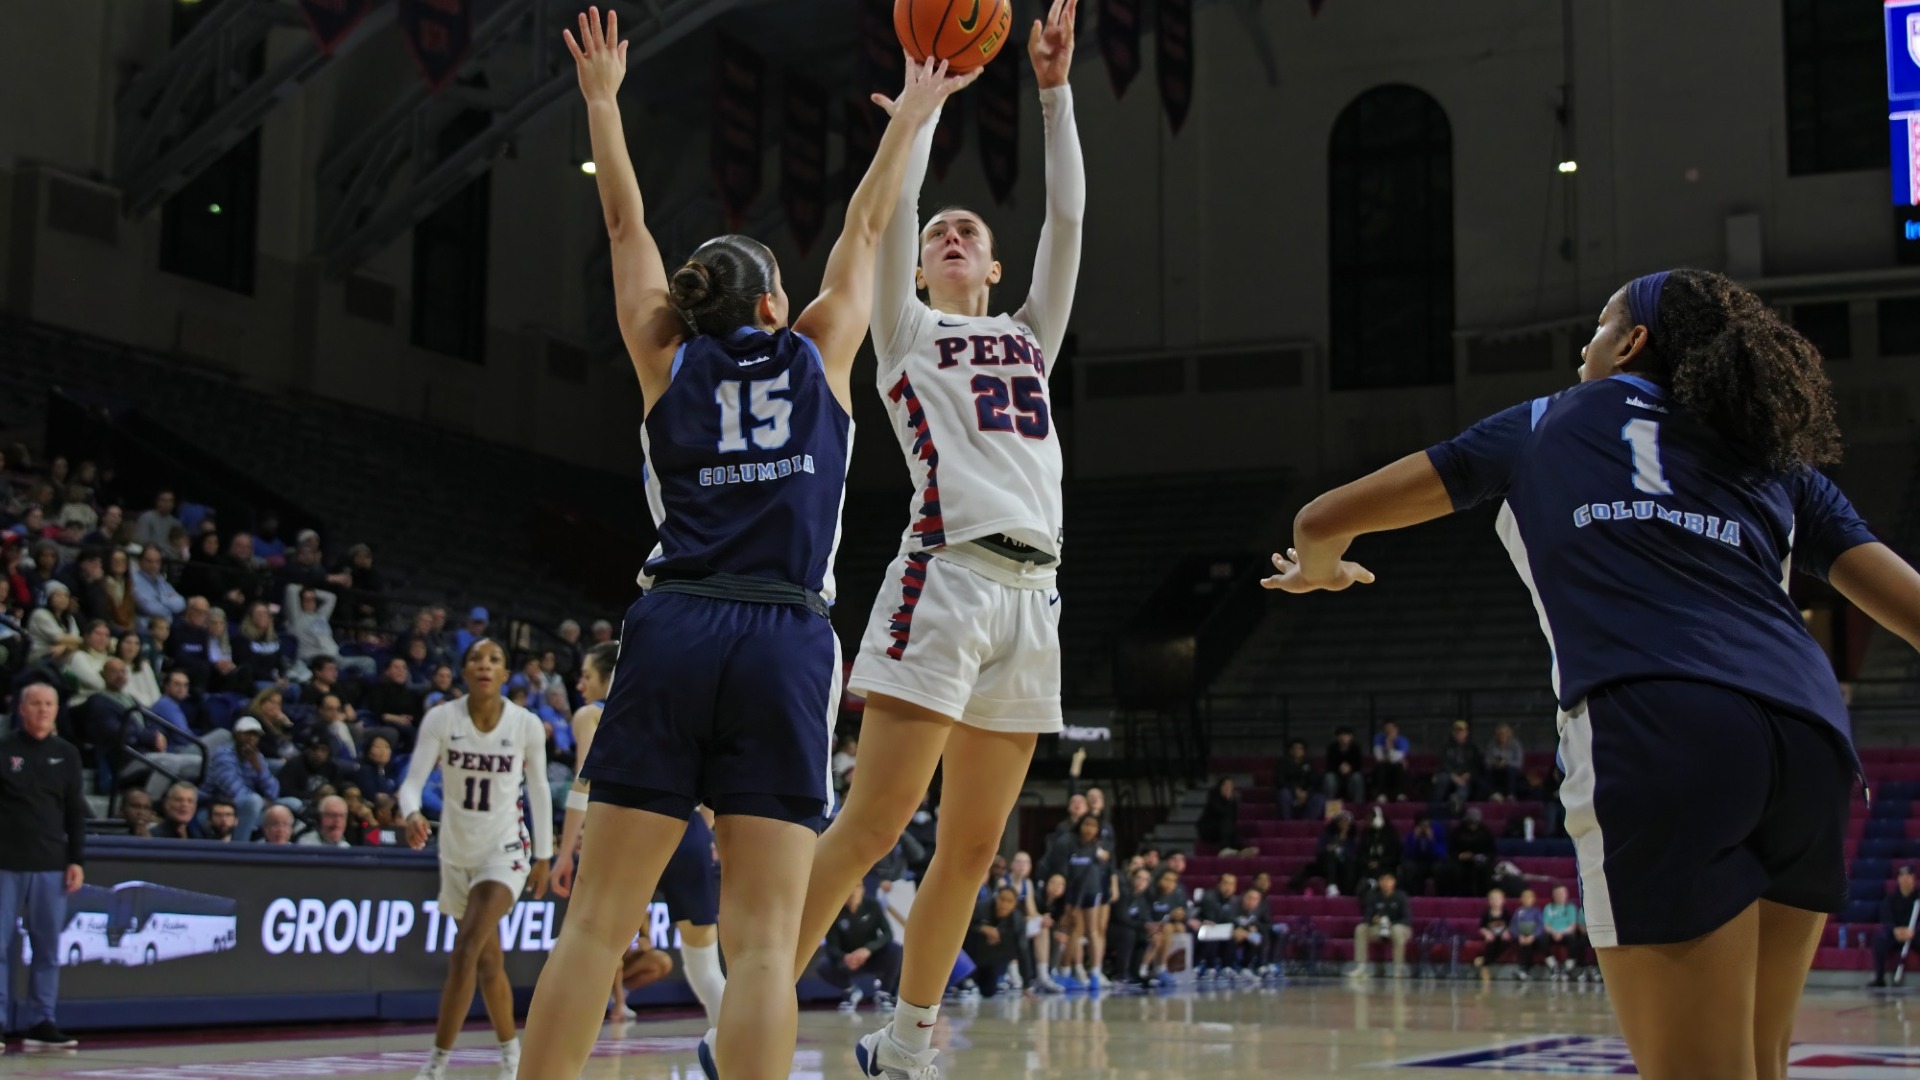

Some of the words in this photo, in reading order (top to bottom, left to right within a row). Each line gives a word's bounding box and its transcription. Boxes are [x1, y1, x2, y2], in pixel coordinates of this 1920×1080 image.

[980, 0, 1010, 57] ELIT
[934, 333, 1046, 378] PENN
[714, 368, 793, 454] 15
[970, 373, 1049, 441] 25
[699, 453, 815, 486] COLUMBIA
[1621, 417, 1674, 495] 1
[1573, 501, 1741, 547] COLUMBIA
[447, 748, 515, 773] PENN
[463, 776, 491, 812] 11
[260, 897, 415, 954] GROUP
[421, 899, 557, 952] TVEL
